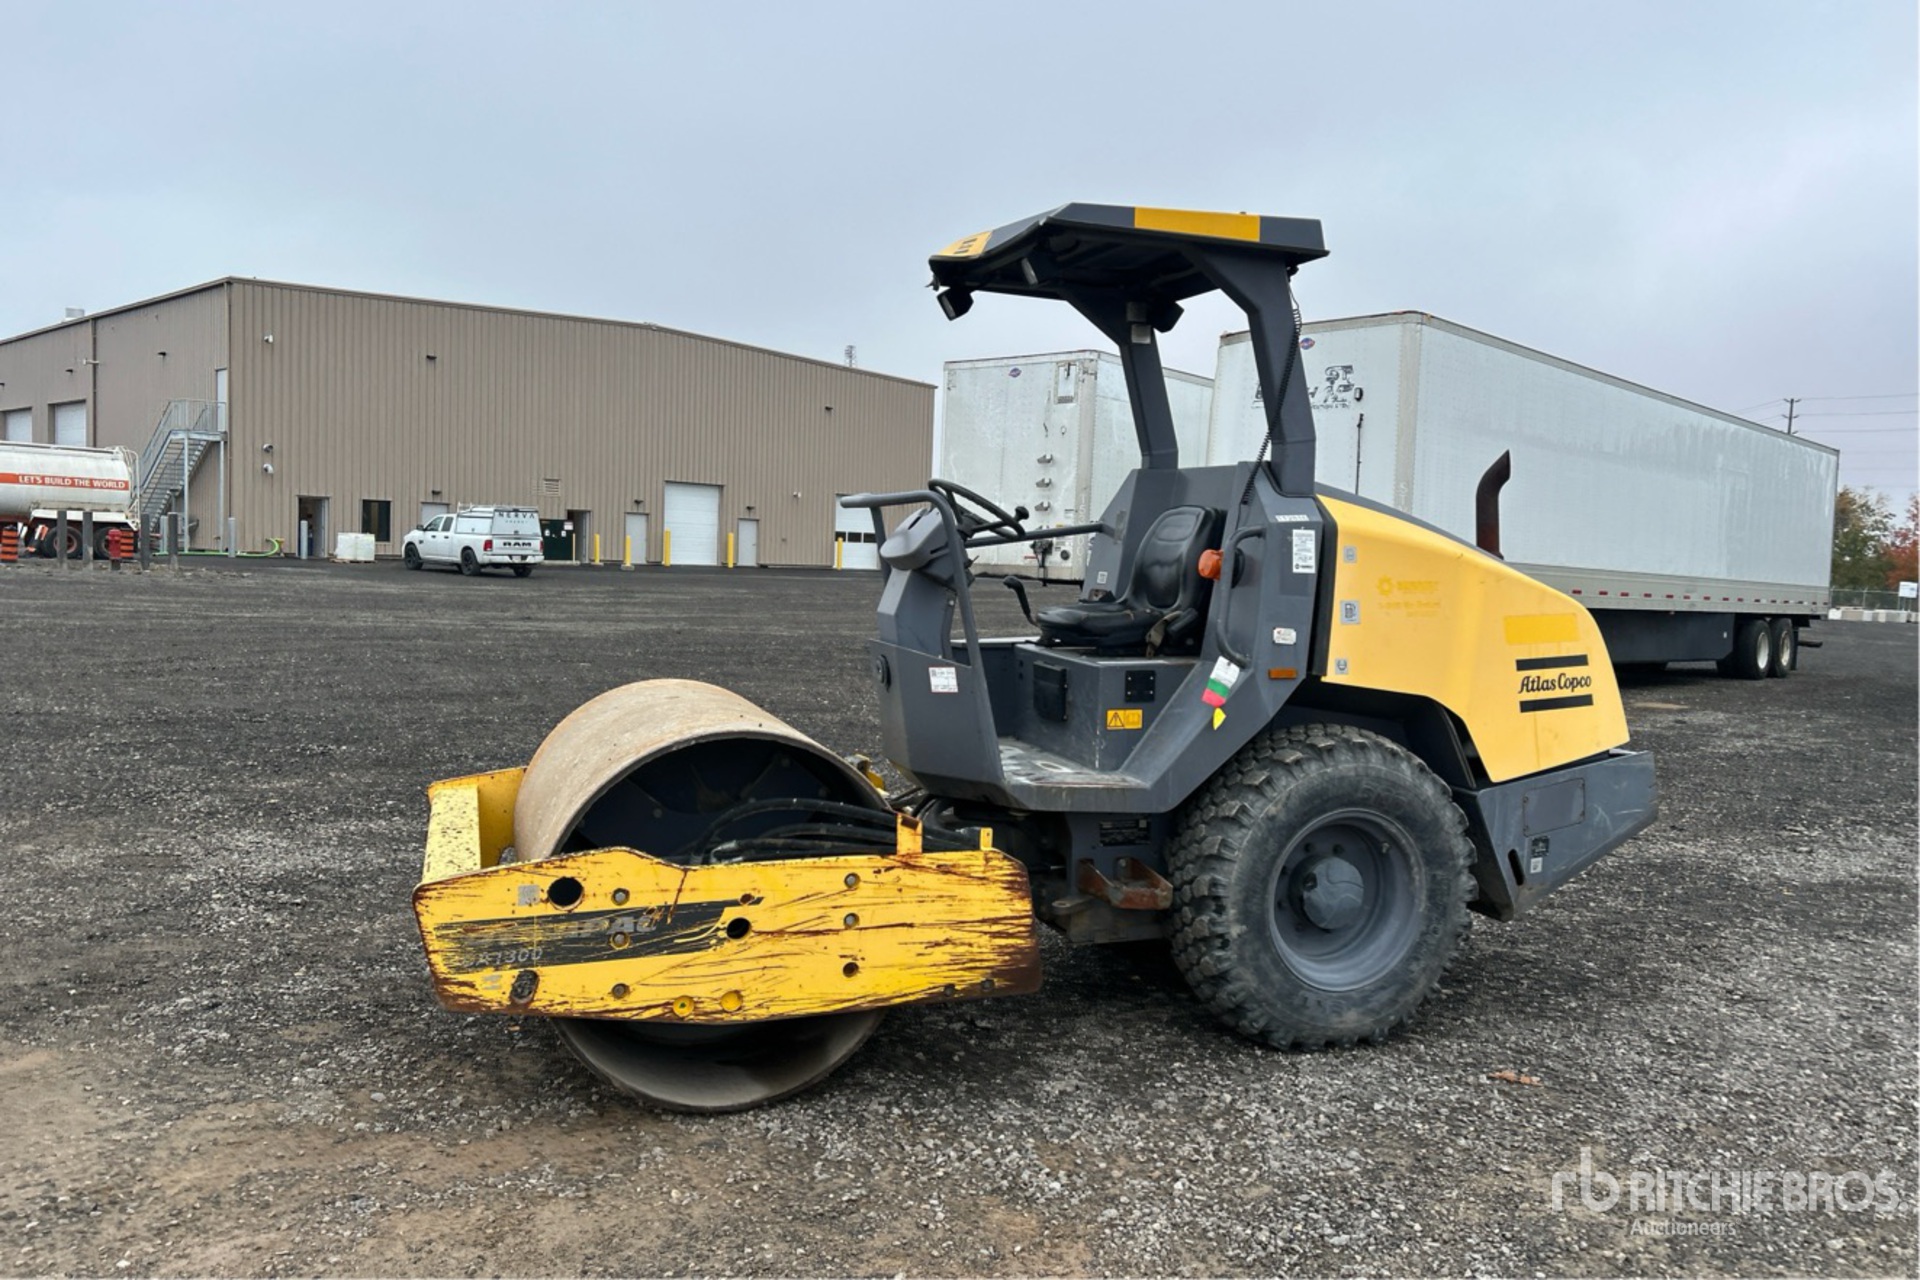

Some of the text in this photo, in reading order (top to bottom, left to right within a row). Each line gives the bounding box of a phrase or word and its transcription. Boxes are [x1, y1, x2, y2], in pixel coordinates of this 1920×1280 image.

[18, 475, 126, 489] LET'S BUILD THE WORLD
[1518, 672, 1592, 694] Atlas Copco
